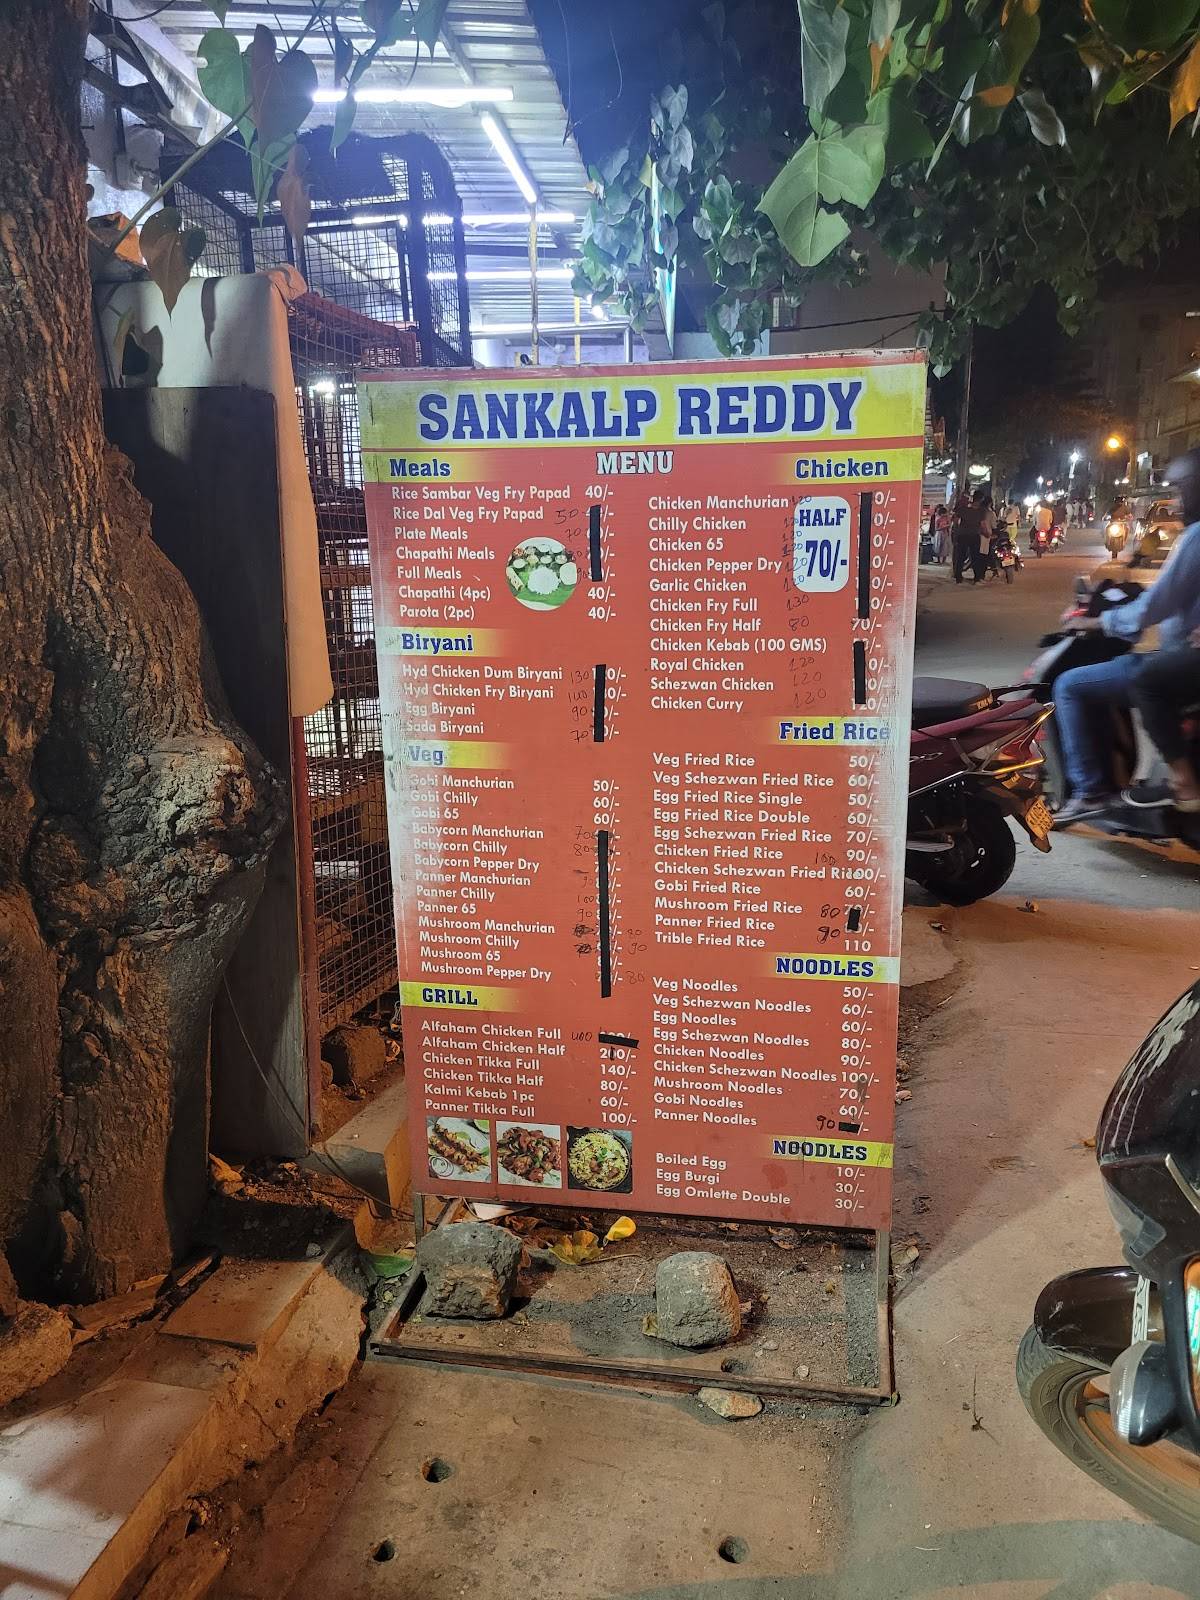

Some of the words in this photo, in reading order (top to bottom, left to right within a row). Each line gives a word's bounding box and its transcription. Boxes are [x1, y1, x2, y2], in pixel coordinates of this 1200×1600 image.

[419, 389, 657, 441] SANKALP
[678, 381, 862, 435] REDDY
[390, 459, 450, 476] Meals
[597, 450, 674, 474] MENU
[796, 458, 888, 478] Chicken
[392, 486, 418, 499] Rice
[422, 486, 471, 499] Sambar
[475, 486, 500, 502] Veg
[504, 486, 525, 503] Fry
[530, 485, 570, 502] Papad
[585, 484, 613, 502] 40/-
[649, 496, 701, 510] Chicken
[707, 495, 789, 509] Manchurian
[393, 507, 419, 519] Rice
[424, 506, 445, 519] Dal
[449, 506, 474, 523] Veg
[478, 506, 499, 523] Fry
[503, 506, 543, 523] Papad
[799, 509, 846, 527] HALF
[395, 526, 426, 539] Plate
[430, 526, 468, 540] Meals
[649, 517, 688, 534] Chilly
[693, 516, 746, 530] Chicken
[649, 537, 701, 551] Chicken
[706, 537, 723, 550] 65
[396, 546, 453, 562] Chapathi
[457, 546, 495, 560] Meals
[805, 540, 847, 581] 70/-
[398, 566, 420, 579] Full
[425, 566, 462, 579] Meals
[650, 558, 701, 571] Chicken
[707, 558, 753, 574] Pepper
[758, 557, 782, 574] Dry
[650, 578, 689, 591] Garlic
[694, 578, 746, 591] Chicken
[399, 585, 455, 601] Chapathi
[460, 586, 490, 602] (4pc)
[588, 585, 616, 603] 40/-
[400, 605, 439, 617] Parota
[444, 605, 474, 621] (2pc)
[588, 605, 616, 622] 40/-
[650, 598, 701, 611] Chicken
[707, 598, 728, 615] Fry
[733, 597, 757, 611] Full
[650, 618, 702, 631] Chicken
[707, 618, 728, 635] Fry
[733, 618, 761, 631] Half
[402, 634, 473, 654] Biryani
[650, 638, 702, 651] Chicken
[707, 638, 750, 651] Kebab
[755, 638, 785, 654] (100
[790, 638, 826, 653] GMS)
[403, 664, 427, 679] Hyd
[432, 665, 480, 678] Chicken
[484, 666, 513, 679] Dum
[517, 666, 562, 682] Biryani
[651, 657, 687, 673] Royal
[692, 657, 744, 671] Chicken
[651, 696, 702, 709] Chicken
[707, 697, 743, 713] Curry
[780, 722, 834, 740] Fried
[843, 723, 890, 740] Rice
[408, 746, 444, 765] Veg
[653, 752, 679, 768] Veg
[685, 753, 720, 765] Fried
[725, 754, 755, 766] Rice
[849, 755, 880, 770] 50/-
[654, 825, 679, 841] Egg
[684, 827, 756, 840] Schezwan
[761, 829, 796, 841] Fried
[802, 829, 832, 842] Rice
[847, 830, 878, 846] 70/-
[654, 843, 708, 856] Chicken
[714, 845, 748, 858] Fried
[753, 847, 783, 859] Rice
[847, 849, 877, 864] 90/-
[654, 879, 687, 891] Gobi
[692, 880, 726, 893] Fried
[732, 882, 761, 894] Rice
[845, 886, 876, 901] 60/-
[655, 896, 728, 911] Mushroom
[734, 900, 768, 912] Fried
[773, 901, 802, 913] Rice
[419, 916, 480, 930] Mushroom
[485, 919, 555, 933] Manchurian
[655, 914, 702, 927] Panner
[707, 916, 740, 929] Fried
[746, 918, 775, 930] Rice
[655, 931, 693, 944] Trible
[698, 933, 731, 946] Fried
[736, 935, 766, 947] Rice
[845, 940, 871, 951] 110
[421, 961, 483, 975] Mushroom
[487, 965, 528, 980] Pepper
[530, 967, 551, 982] Dry
[777, 958, 874, 977] NOODLES
[422, 988, 477, 1005] GRILL
[653, 977, 678, 991] Veg
[683, 978, 738, 992] Noodles
[843, 986, 873, 1001] 50/-
[421, 1020, 477, 1034] Alfaham
[481, 1024, 532, 1037] Chicken
[537, 1027, 561, 1039] Full
[653, 1010, 677, 1025] Egg
[682, 1012, 736, 1025] Noodles
[841, 1021, 872, 1035] 60/-
[654, 1027, 677, 1041] Egg
[682, 1029, 748, 1044] Schezwan
[754, 1033, 809, 1046] Noodles
[842, 1038, 871, 1052] 80/-
[423, 1052, 472, 1065] Chicken
[477, 1056, 511, 1068] Tikka
[516, 1058, 539, 1070] Full
[601, 1064, 636, 1079] 140/-
[654, 1044, 704, 1057] Chicken
[710, 1047, 764, 1060] Noodles
[841, 1055, 871, 1069] 90/-
[424, 1068, 473, 1081] Chicken
[477, 1071, 512, 1084] Tikka
[517, 1074, 544, 1086] Half
[600, 1080, 628, 1094] 80/-
[654, 1076, 723, 1091] Mushroom
[728, 1081, 783, 1094] Noodles
[425, 1083, 461, 1096] Kalmi
[466, 1086, 507, 1099] Kebab
[512, 1090, 534, 1103] 1pc
[600, 1096, 629, 1110] 60/-
[425, 1099, 468, 1112] Panner
[472, 1102, 506, 1115] Tikka
[512, 1105, 534, 1117] Full
[602, 1112, 637, 1126] 100/-
[655, 1108, 699, 1121] Panner
[703, 1112, 757, 1125] Noodles
[774, 1140, 867, 1160] NOODLES
[656, 1152, 697, 1165] Boiled
[702, 1156, 726, 1170] Egg
[837, 1167, 865, 1180] 10/-
[656, 1168, 680, 1182] Egg
[685, 1171, 719, 1185] Burgi
[836, 1183, 864, 1197] 30/-
[657, 1184, 680, 1198] Egg
[685, 1186, 737, 1200] Omlette
[742, 1190, 790, 1204] Double
[835, 1198, 864, 1212] 30/-
